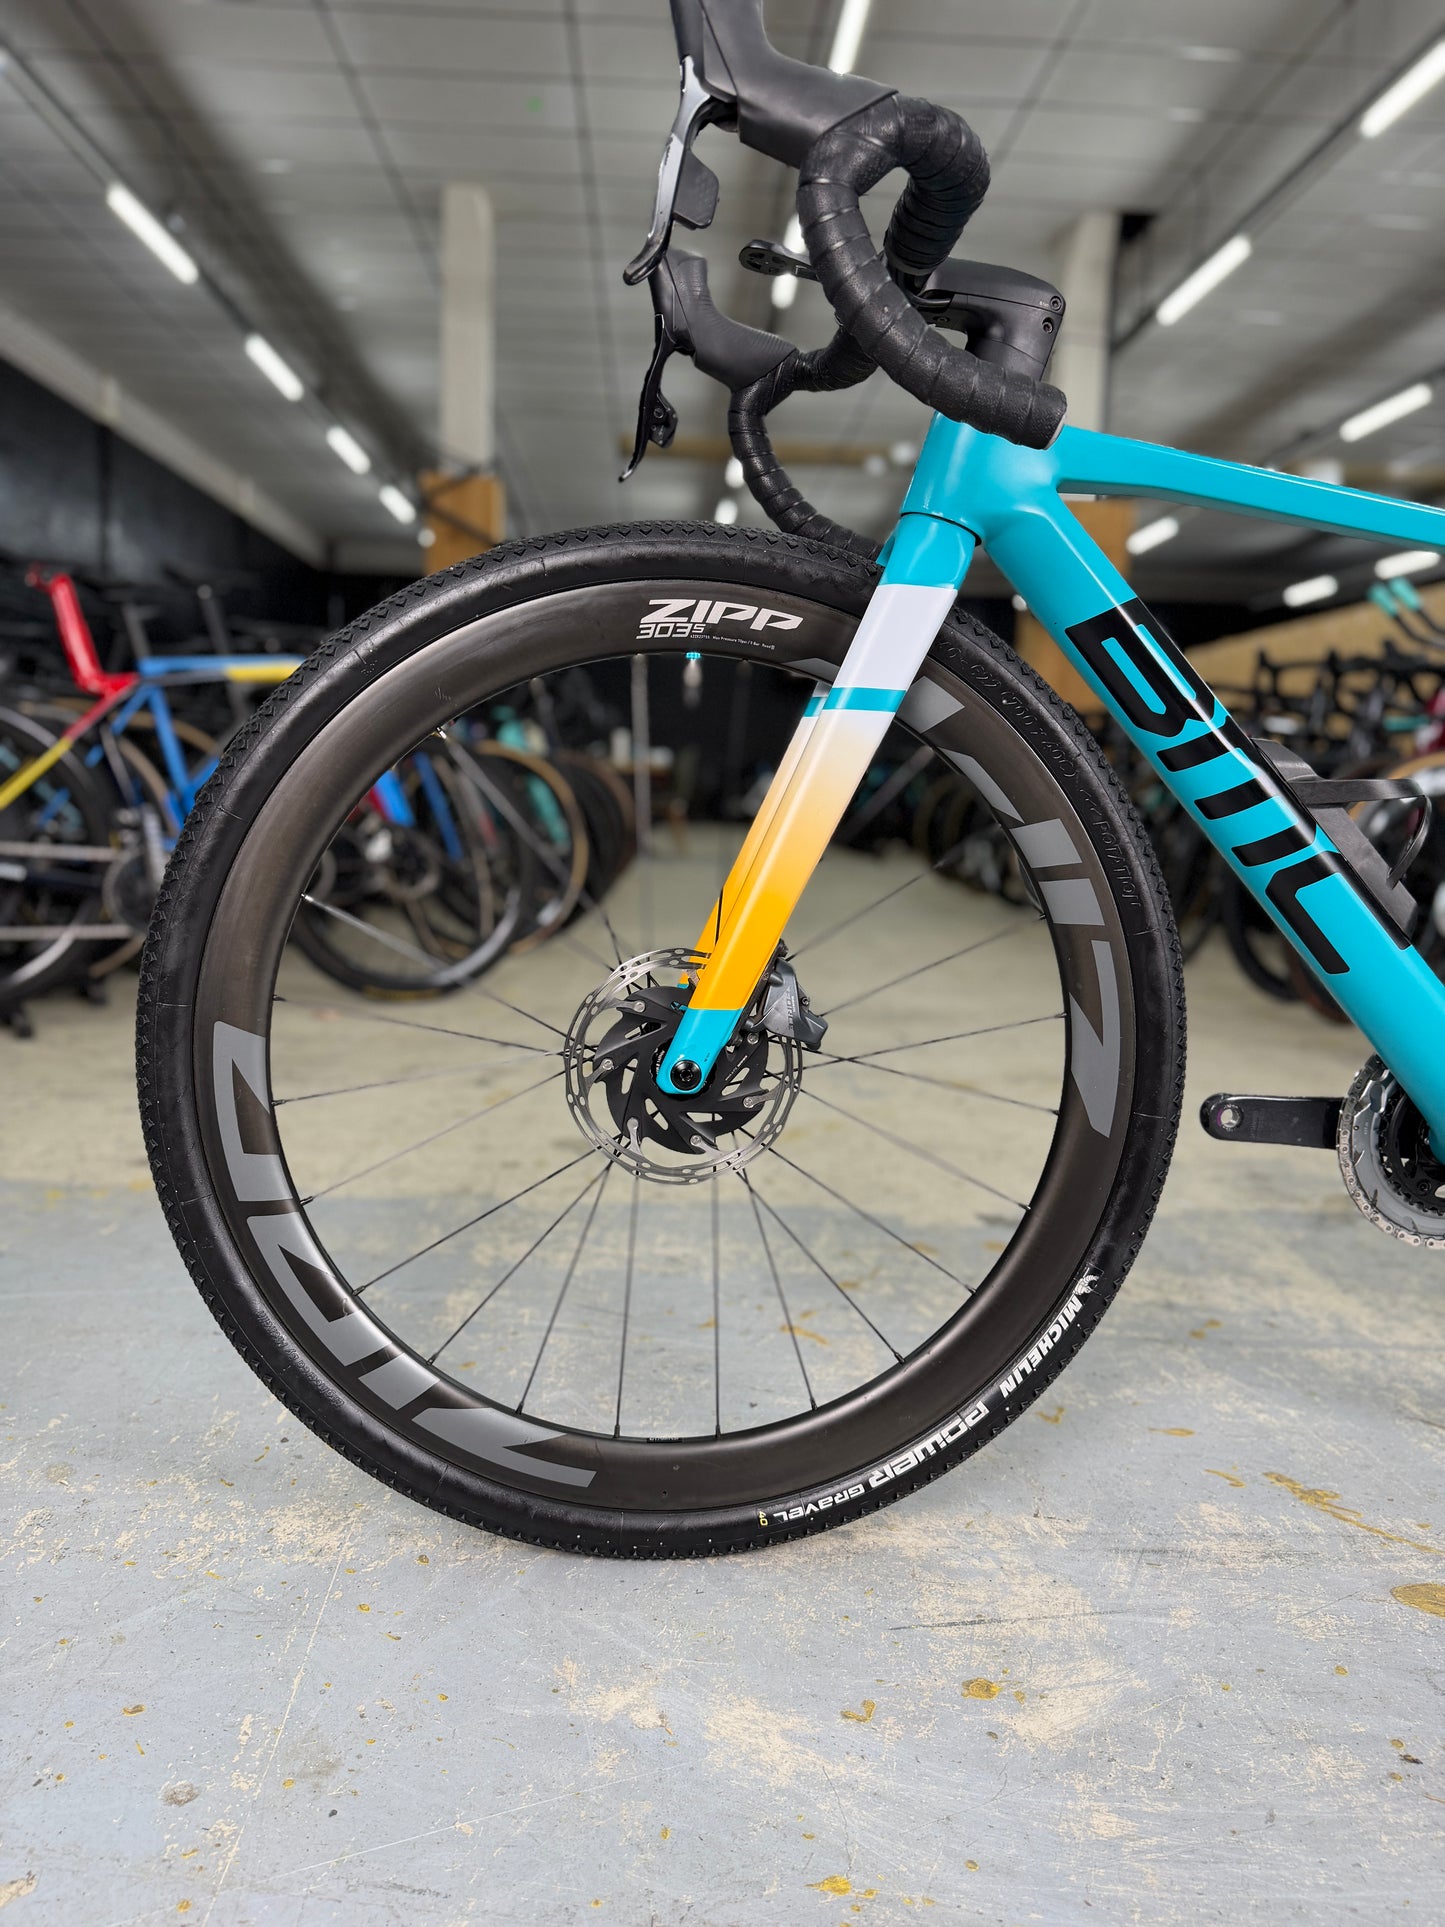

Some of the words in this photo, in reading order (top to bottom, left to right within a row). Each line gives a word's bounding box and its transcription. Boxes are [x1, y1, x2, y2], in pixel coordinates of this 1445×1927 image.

[640, 599, 804, 631] ZIPP
[1064, 596, 1412, 975] BMC
[212, 1020, 598, 1489] ZIPP
[999, 1294, 1084, 1398] MICHELIN
